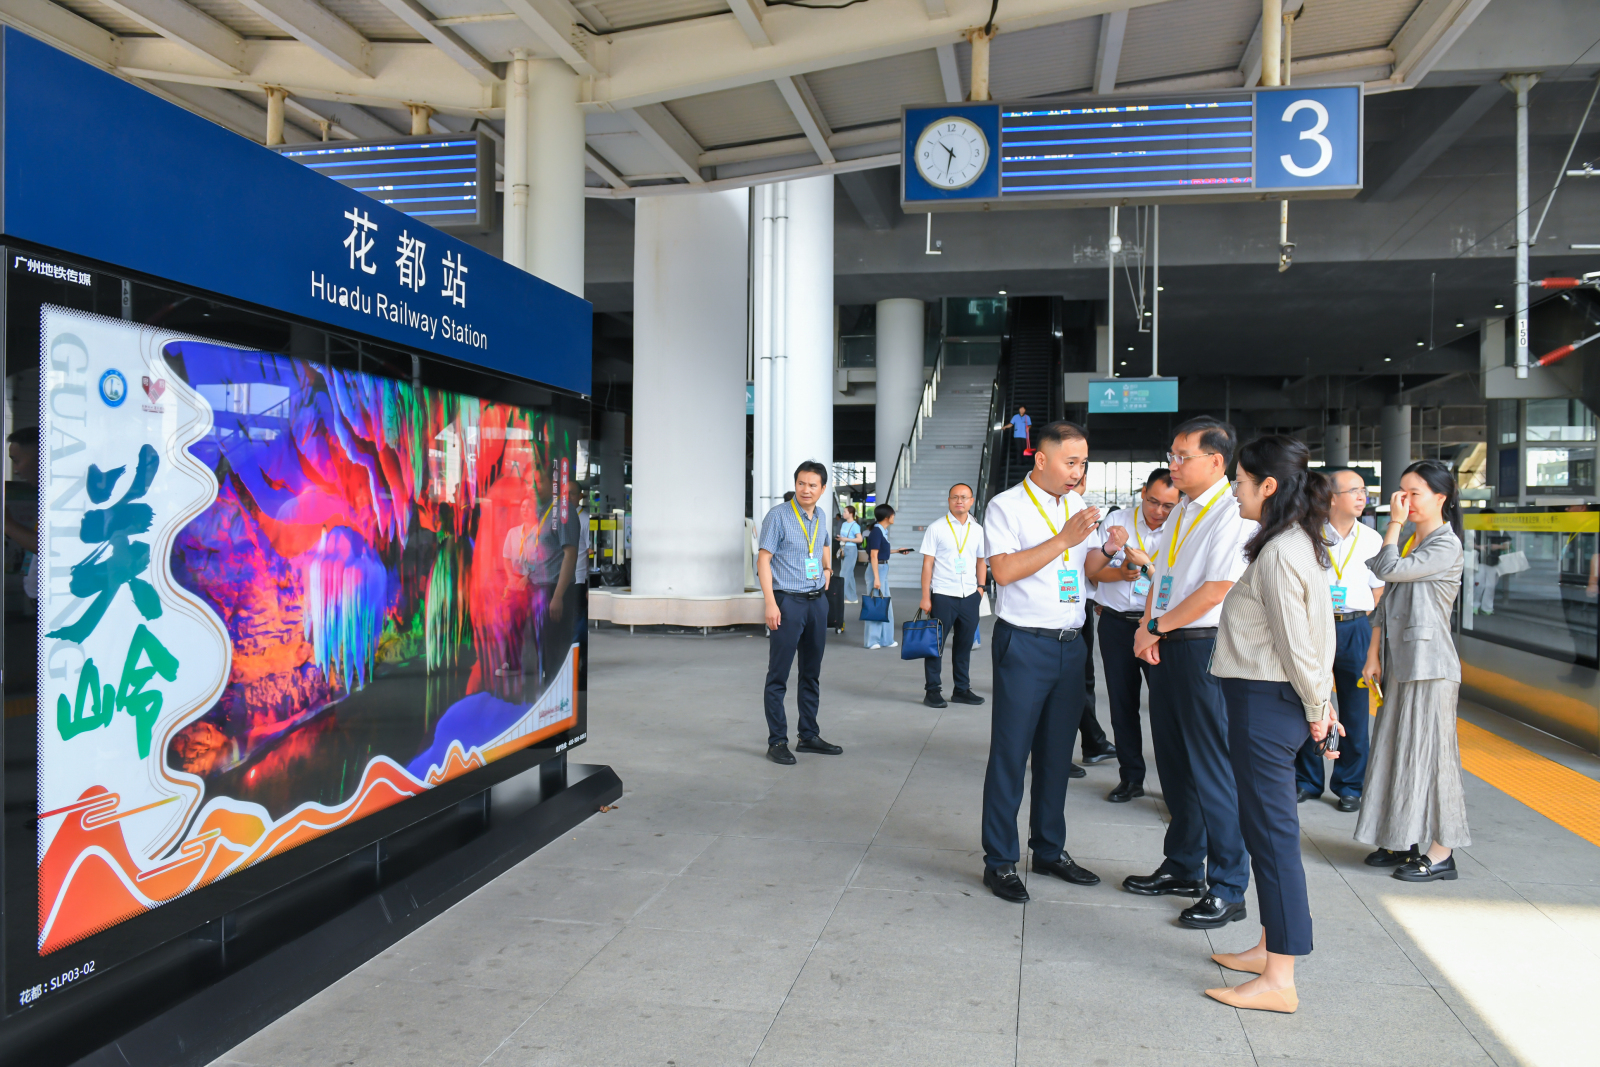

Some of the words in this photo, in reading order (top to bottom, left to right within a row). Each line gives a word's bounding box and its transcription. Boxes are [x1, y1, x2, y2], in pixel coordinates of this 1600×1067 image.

[947, 124, 957, 133] 12
[1280, 99, 1333, 177] 3
[974, 149, 980, 157] 3
[948, 176, 955, 185] 6
[14, 256, 92, 287] 广州地铁传媒
[343, 207, 468, 308] 花都站
[311, 270, 372, 315] Huadu
[376, 293, 438, 340] Railway
[441, 315, 488, 350] Station
[1519, 320, 1527, 346] 150
